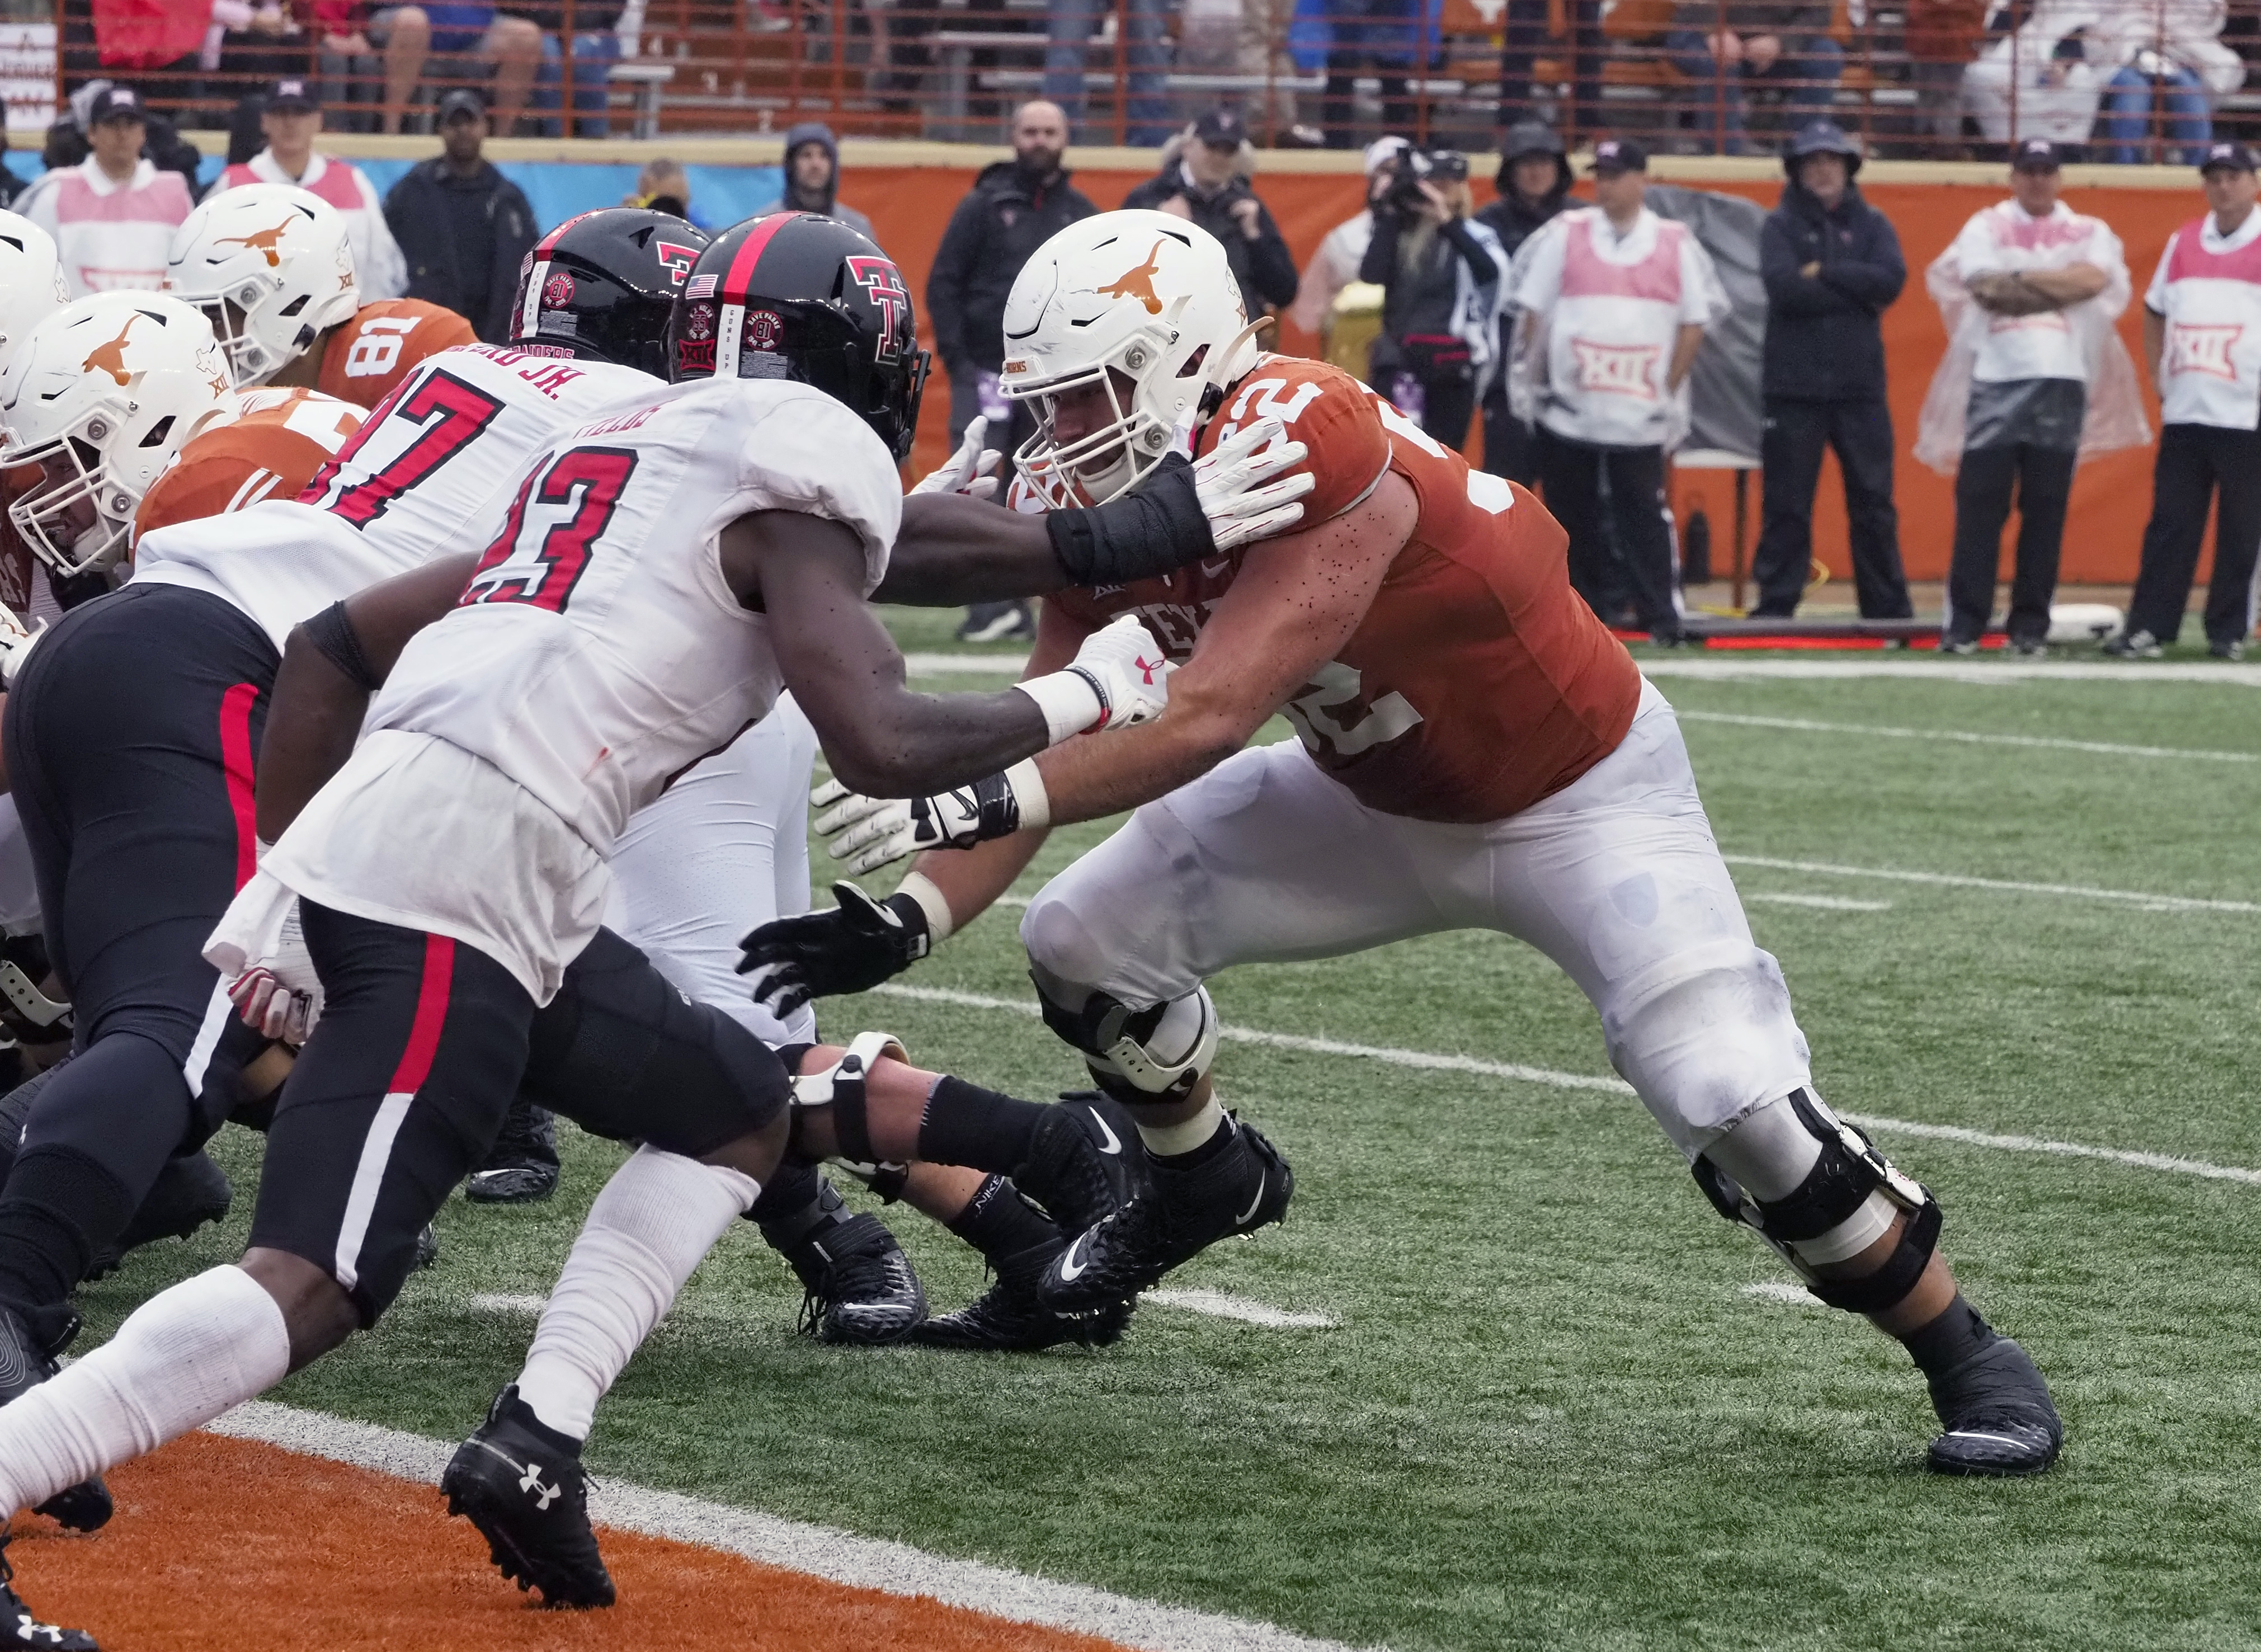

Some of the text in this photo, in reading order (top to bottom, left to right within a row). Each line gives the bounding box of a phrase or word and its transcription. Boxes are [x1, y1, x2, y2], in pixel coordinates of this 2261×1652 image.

[551, 282, 565, 299] 81
[747, 312, 781, 330] DAVE PARKS
[755, 321, 771, 340] 81
[345, 317, 422, 378] 81
[724, 309, 734, 369] GUNS UP
[975, 1175, 1000, 1209] NIKE
